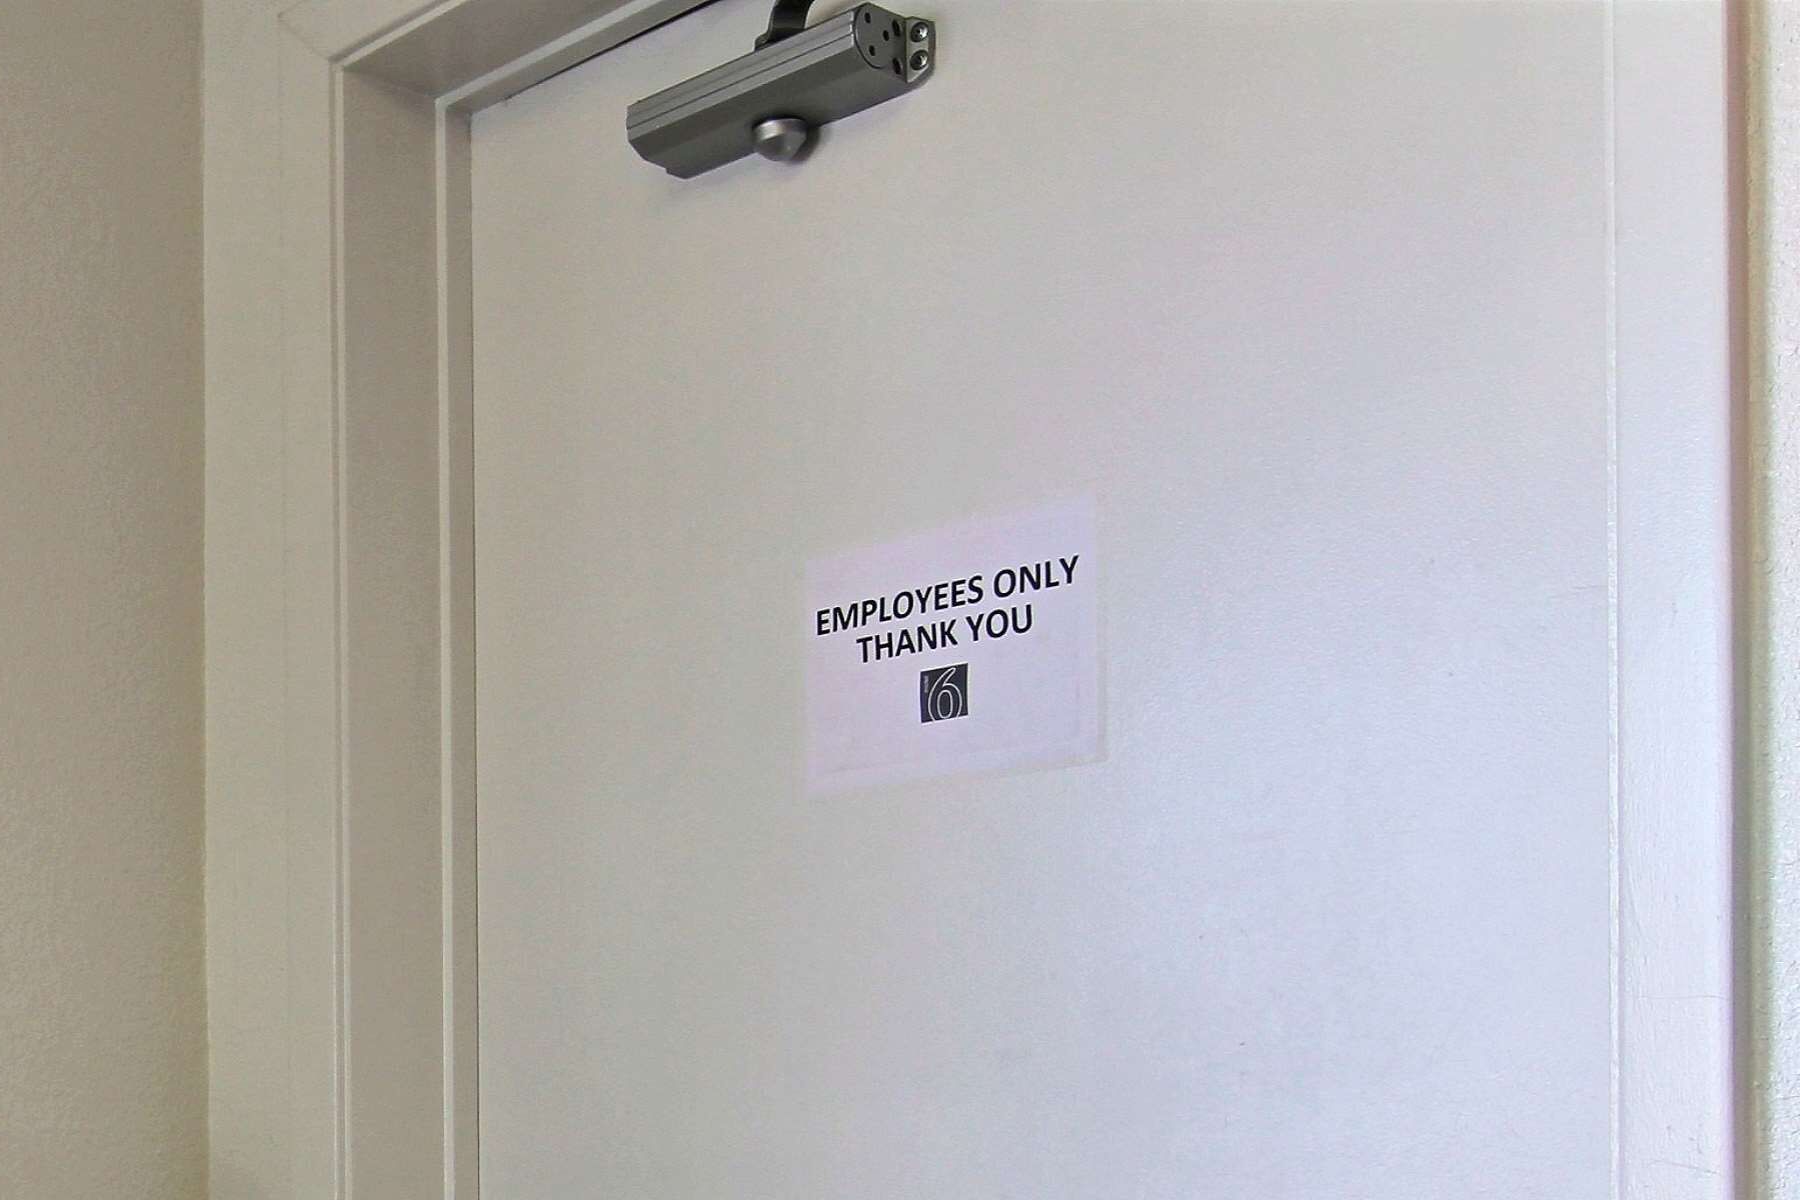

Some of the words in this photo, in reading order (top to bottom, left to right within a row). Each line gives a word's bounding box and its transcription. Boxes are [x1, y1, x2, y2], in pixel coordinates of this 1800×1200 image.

[816, 575, 983, 635] EMPLOYEES
[993, 555, 1079, 598] ONLY
[855, 619, 958, 663] THANK
[965, 604, 1033, 642] YOU
[928, 667, 962, 721] 6
